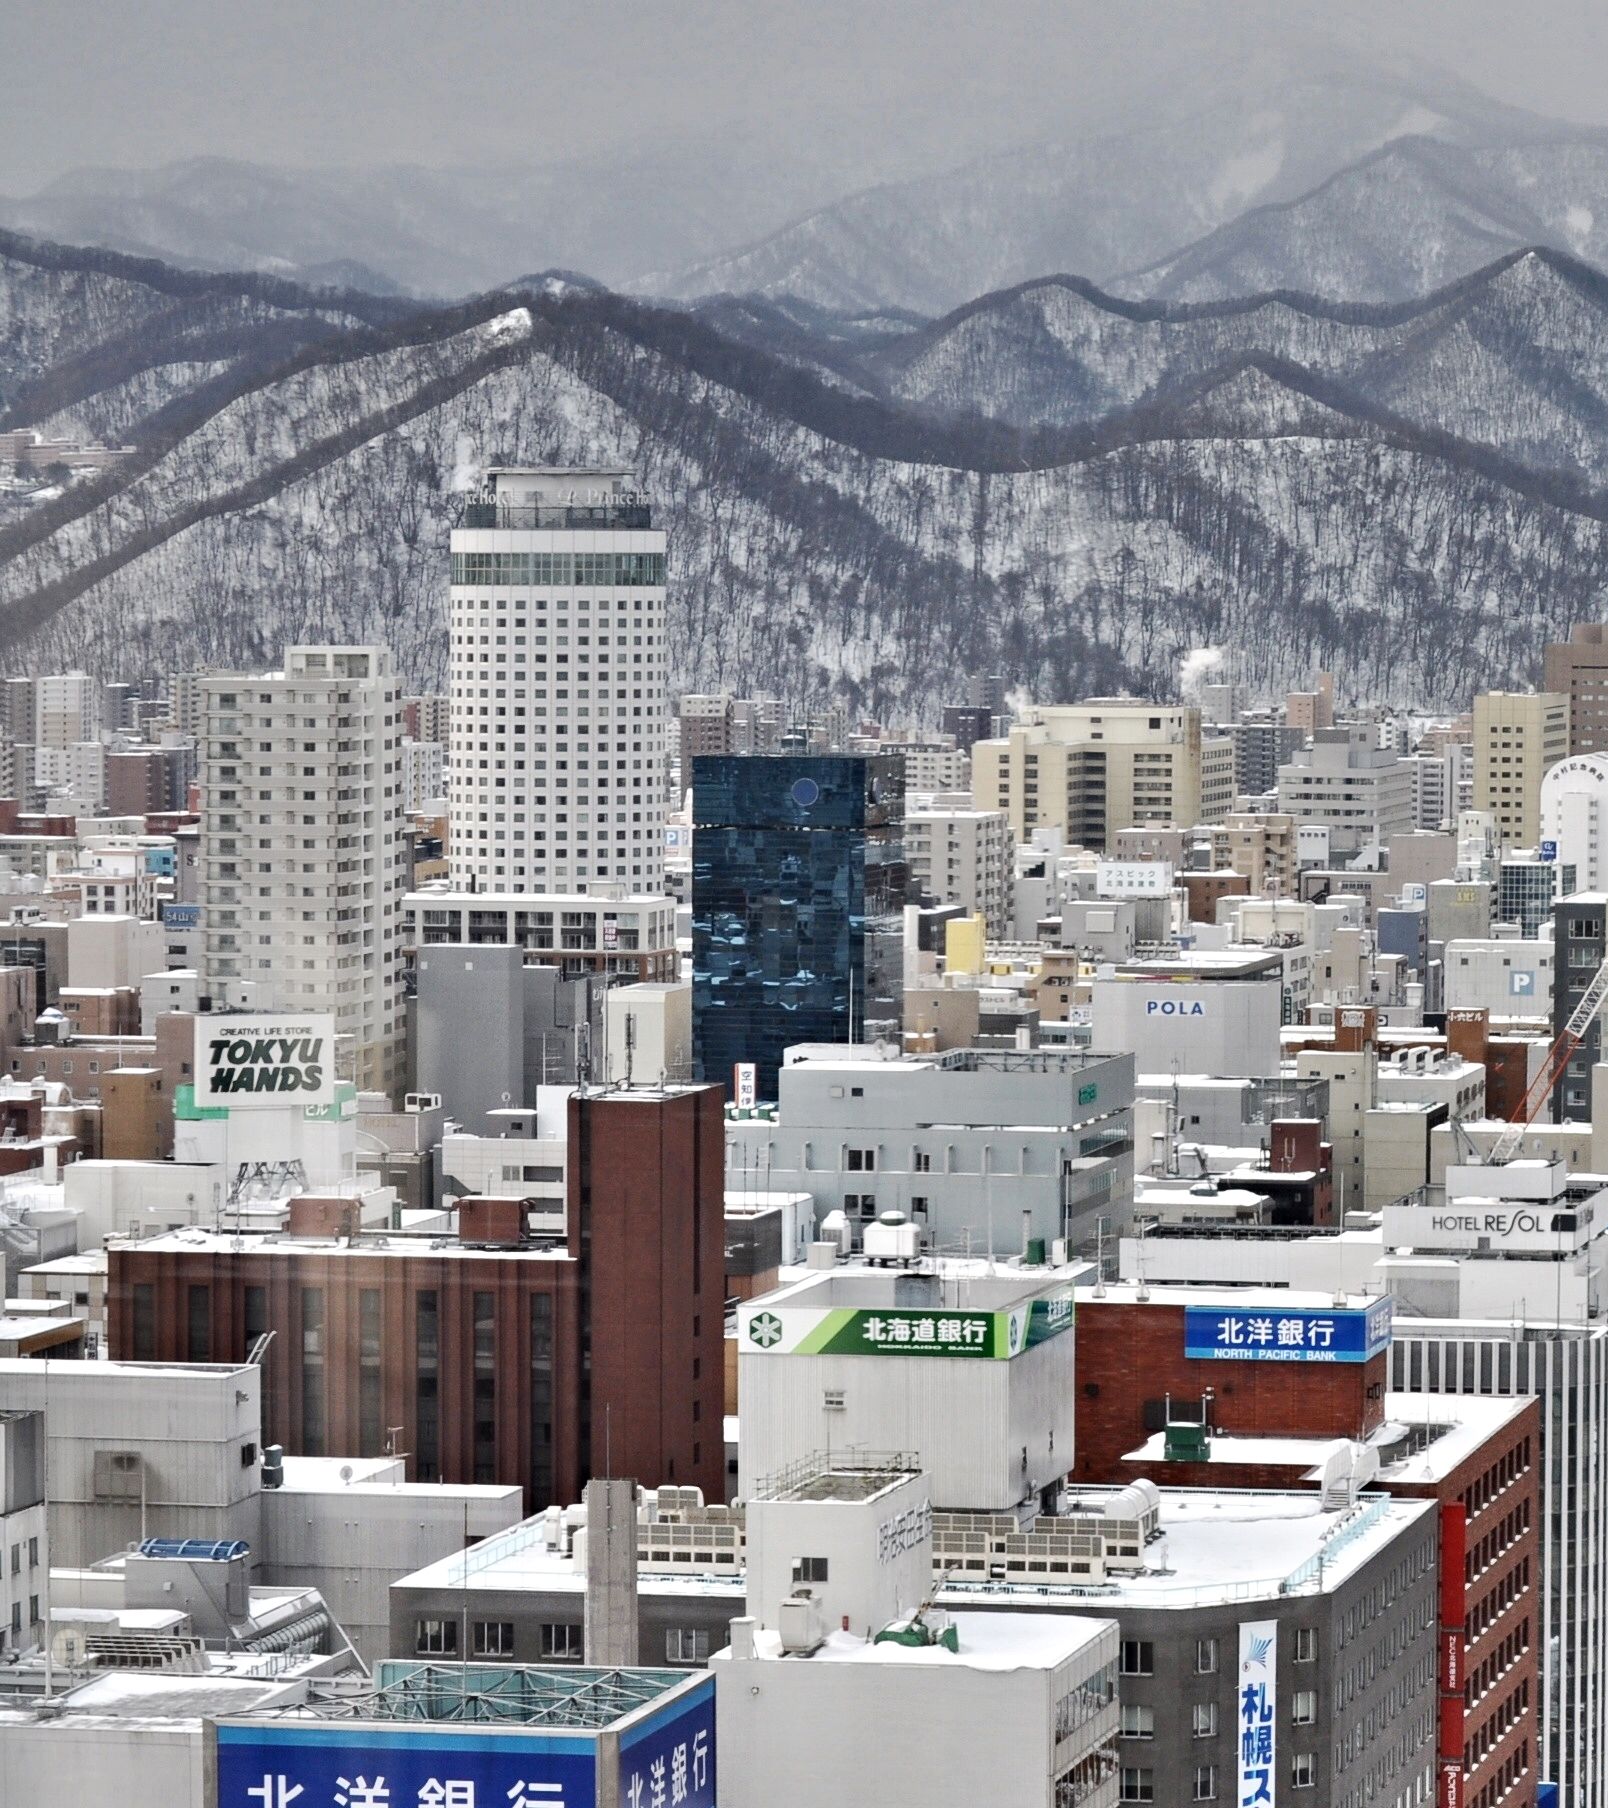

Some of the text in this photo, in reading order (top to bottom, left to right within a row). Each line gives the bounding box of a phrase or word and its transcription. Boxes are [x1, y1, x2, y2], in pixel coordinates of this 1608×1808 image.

[666, 831, 677, 845] P
[1414, 889, 1425, 900] P
[1513, 974, 1530, 992] P
[1147, 1001, 1203, 1015] POLA
[220, 1027, 313, 1036] CREATIVE LIFE STORE
[209, 1038, 323, 1065] TOKYU
[210, 1066, 323, 1093] HANDS
[1432, 1210, 1544, 1236] HOTEL RESOL
[863, 1317, 987, 1344] 北海道銀行
[1217, 1317, 1335, 1346] 北洋銀行
[1214, 1349, 1336, 1361] NORTH PACIFIC BANK
[1241, 1682, 1273, 1807] 札幌ス
[627, 1729, 708, 1808] 北洋銀行
